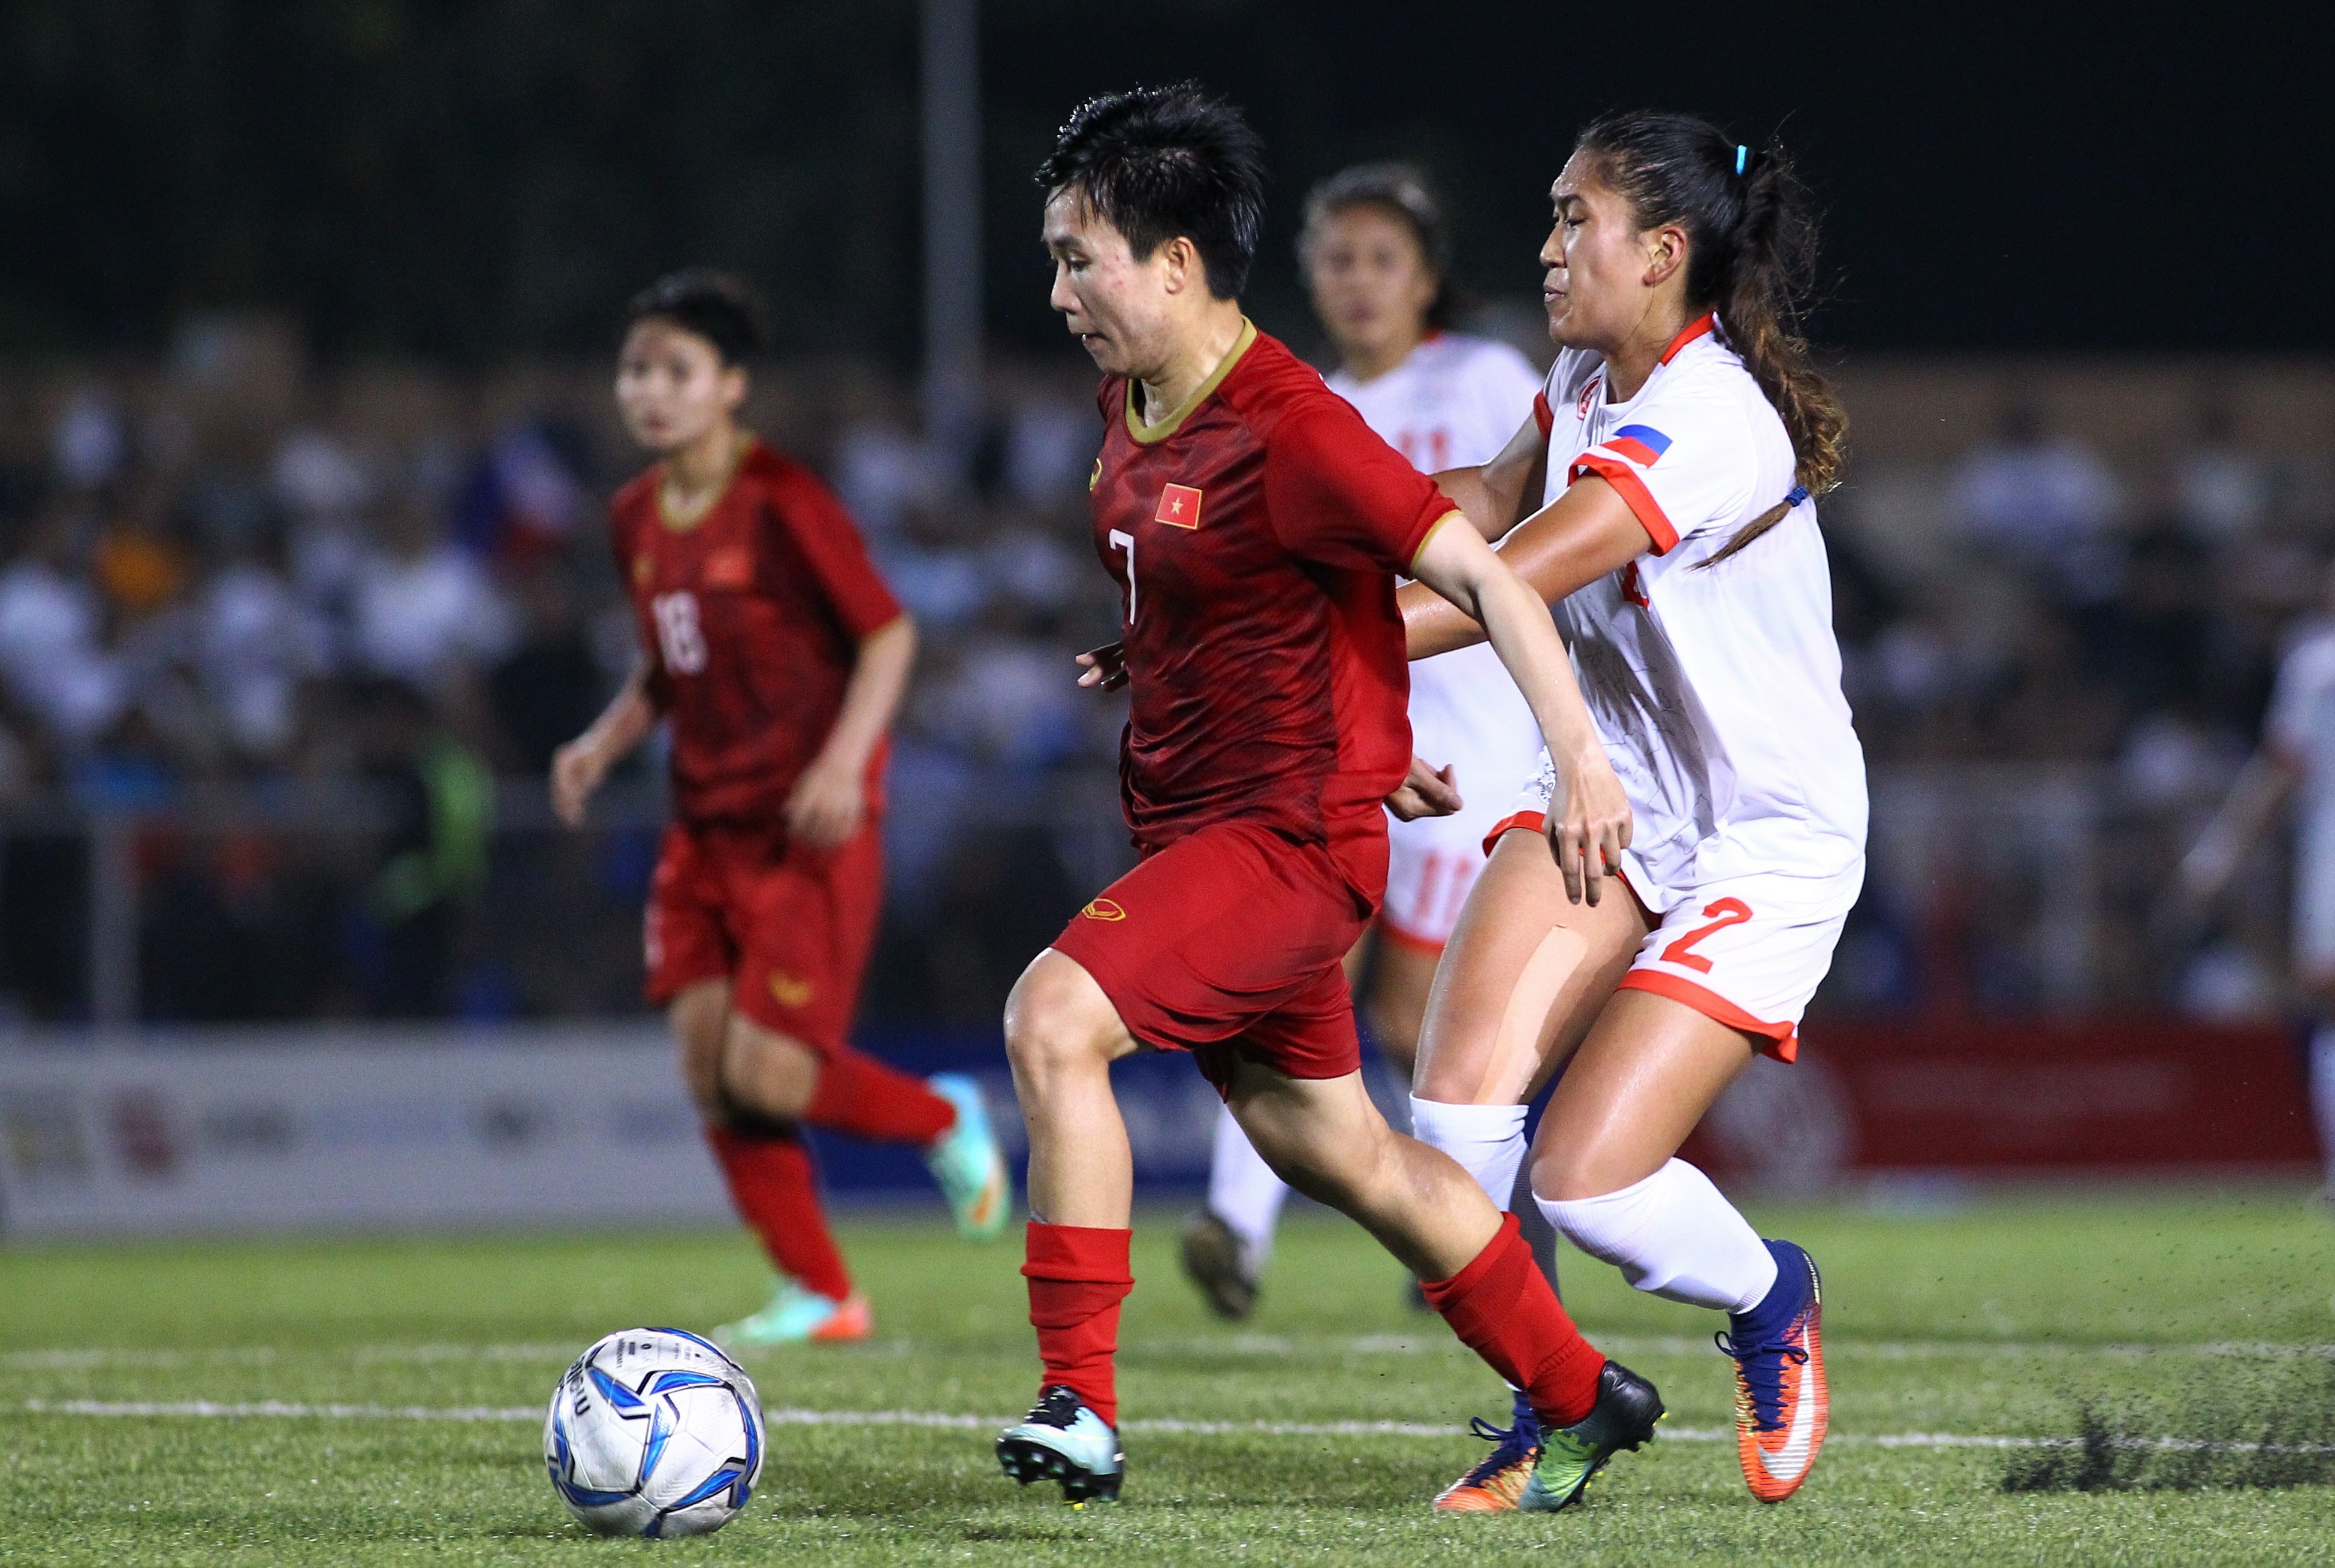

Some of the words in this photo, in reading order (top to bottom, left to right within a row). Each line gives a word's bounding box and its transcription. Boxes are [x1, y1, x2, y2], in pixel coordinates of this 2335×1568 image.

[1108, 527, 1137, 626] 7
[651, 589, 710, 677] 18
[1660, 896, 1754, 975] 2
